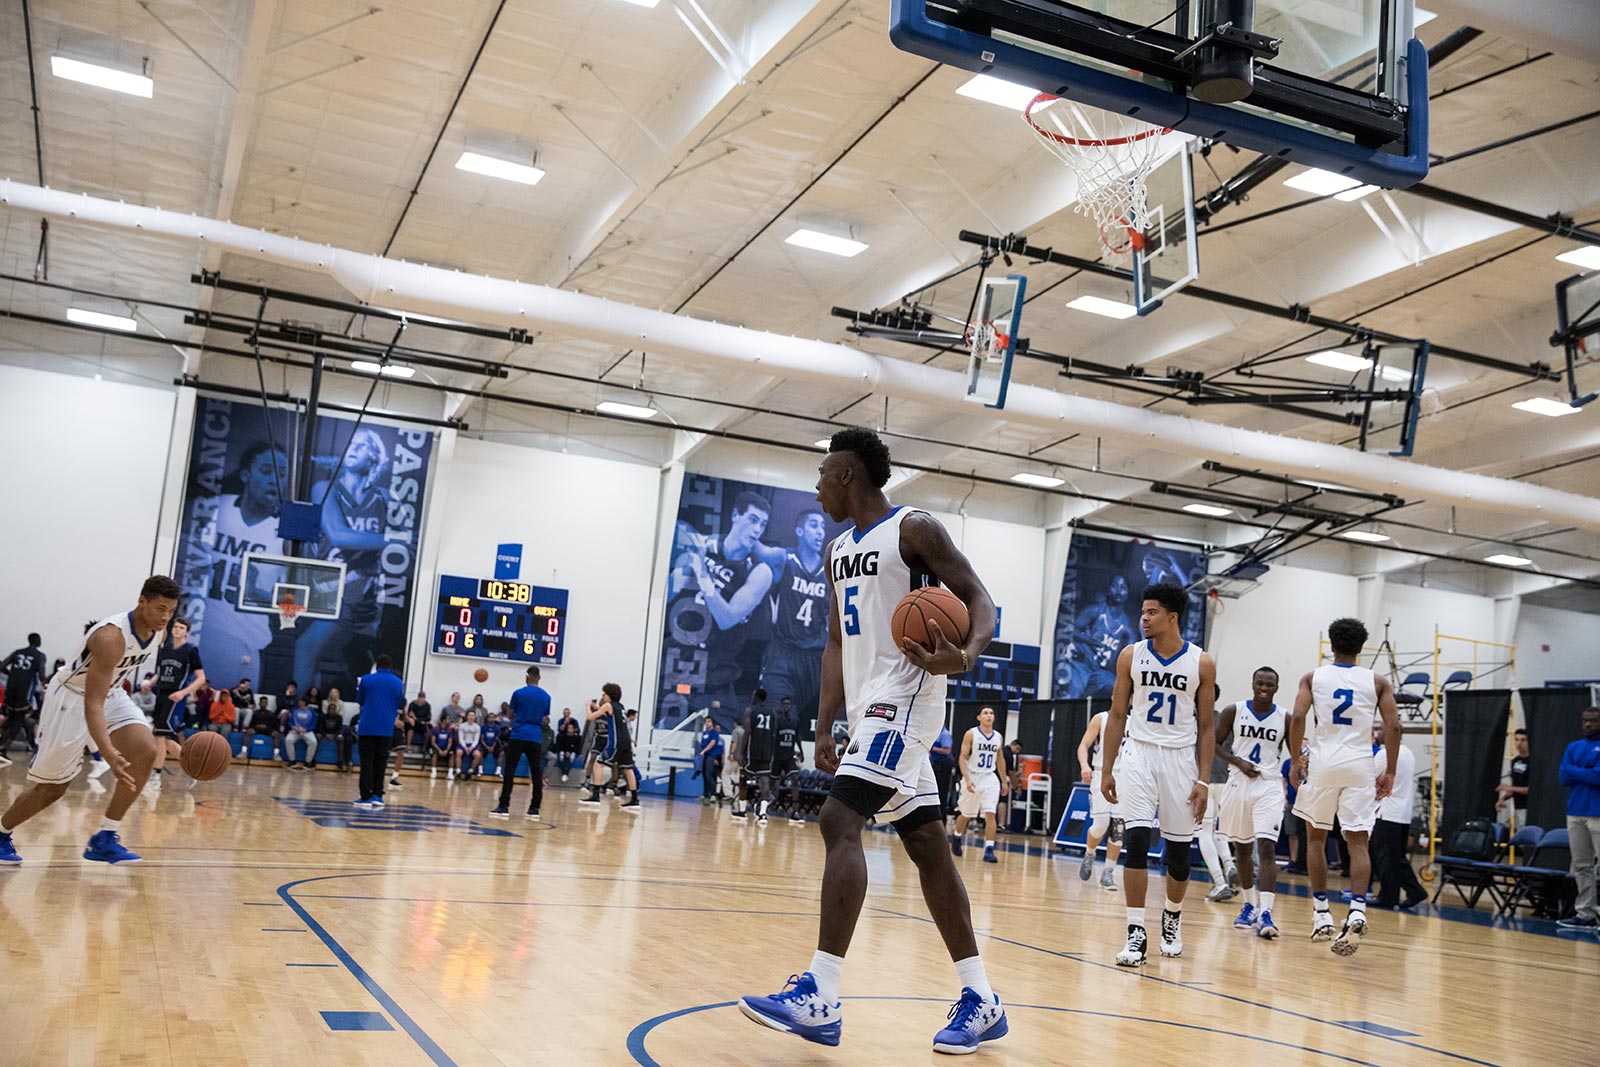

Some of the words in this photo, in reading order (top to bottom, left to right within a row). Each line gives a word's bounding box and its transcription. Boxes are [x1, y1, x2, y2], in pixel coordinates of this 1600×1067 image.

[376, 428, 427, 608] PASSION
[497, 554, 520, 563] COURT
[833, 551, 880, 583] IMG
[487, 581, 530, 603] 10:38
[791, 576, 826, 598] IMG
[450, 596, 471, 607] HOME
[459, 608, 472, 626] 0
[493, 606, 513, 614] PERIOD
[533, 606, 558, 617] GUEST
[796, 598, 814, 627] 4
[844, 585, 861, 636] 5
[440, 624, 458, 632] FOULS
[501, 614, 507, 628] 1
[547, 617, 559, 636] 0
[445, 631, 455, 646] 0
[464, 633, 474, 649] 6
[482, 629, 503, 637] PLAYER
[504, 631, 518, 639] FOUL
[542, 635, 559, 643] FOULS
[437, 646, 456, 654] SCORE
[523, 639, 534, 655] 6
[546, 642, 556, 657] 0
[13, 654, 34, 670] 35
[1141, 671, 1187, 692] IMG
[1146, 692, 1177, 725] 21
[1332, 688, 1354, 726] 2
[756, 714, 771, 730] 21
[1240, 724, 1278, 742] IMG
[978, 743, 998, 752] IMG
[1249, 743, 1261, 764] 4
[977, 753, 993, 768] 30
